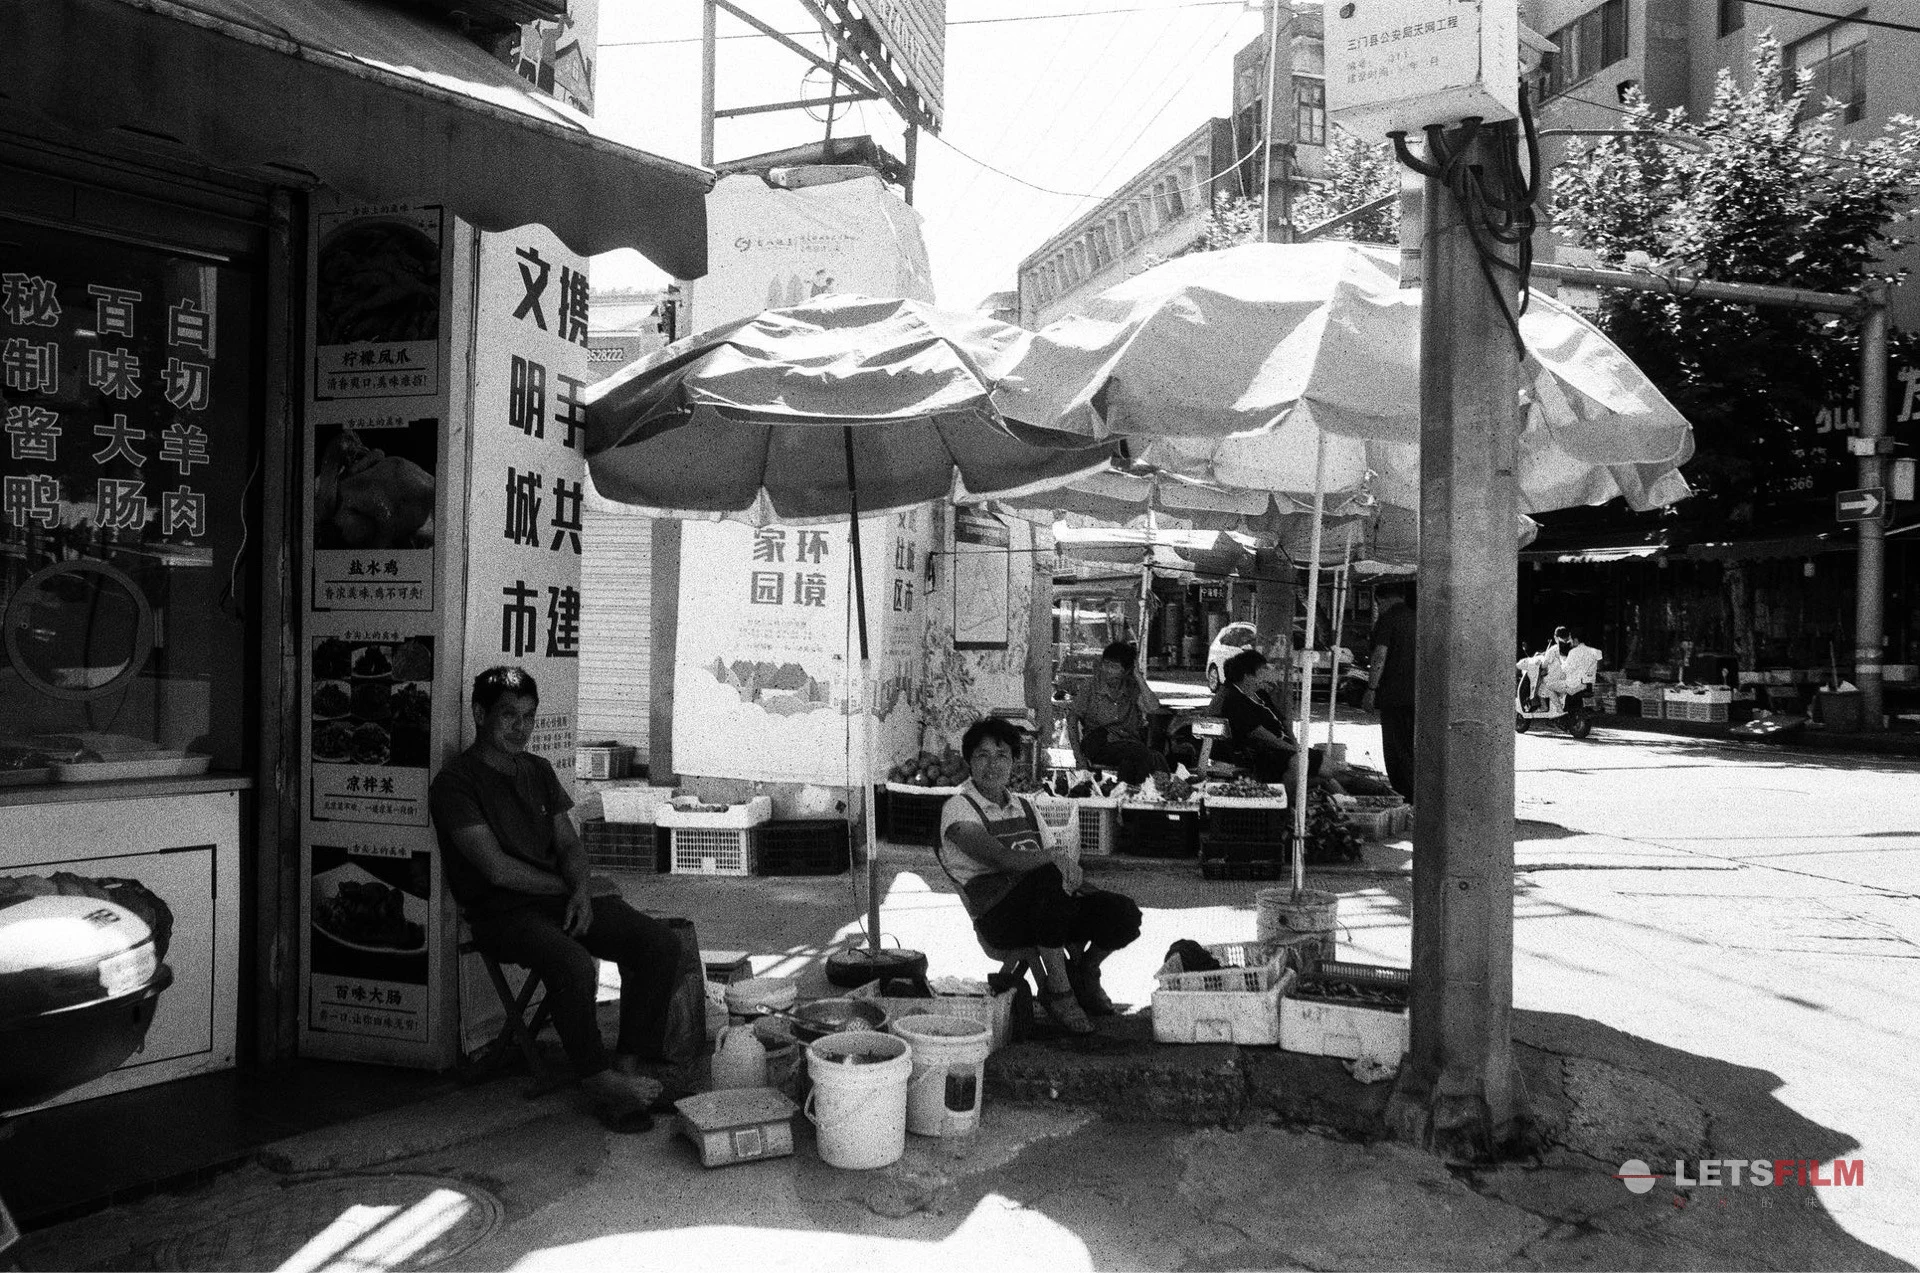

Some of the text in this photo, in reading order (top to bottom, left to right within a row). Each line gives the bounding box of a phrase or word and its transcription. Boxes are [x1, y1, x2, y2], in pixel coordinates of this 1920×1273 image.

[2, 273, 62, 529] 秘制酱鸭
[88, 284, 147, 530] 百味大肠
[160, 298, 210, 536] 白切羊肉
[502, 246, 551, 658] 文明城市
[348, 559, 399, 576] 盐水鸡
[750, 528, 786, 605] 家园
[793, 530, 829, 607] 环境
[346, 775, 395, 793] 凉拌菜
[335, 984, 402, 1005] 百味大肠
